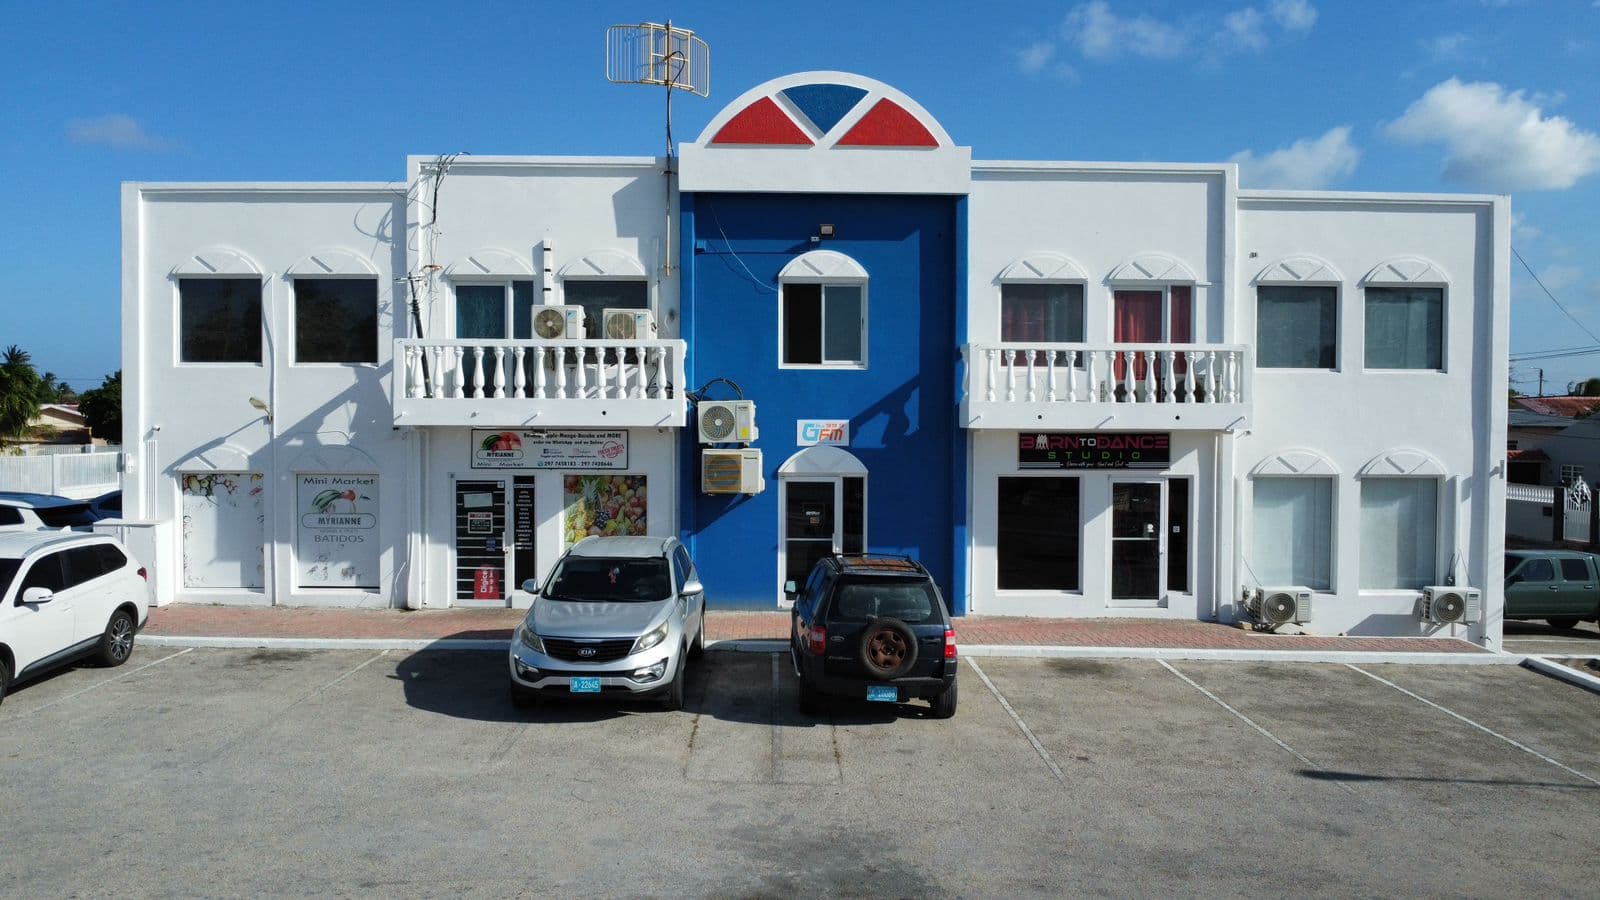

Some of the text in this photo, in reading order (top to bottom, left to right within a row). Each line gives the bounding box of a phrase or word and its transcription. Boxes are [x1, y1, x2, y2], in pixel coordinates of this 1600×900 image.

[1020, 434, 1169, 449] BRN TO DANCE
[1047, 451, 1141, 459] STUDIO
[304, 477, 374, 485] Mini Market
[319, 517, 361, 525] MYRIANNE
[314, 535, 364, 543] BATIDOS
[480, 568, 488, 593] Digice
